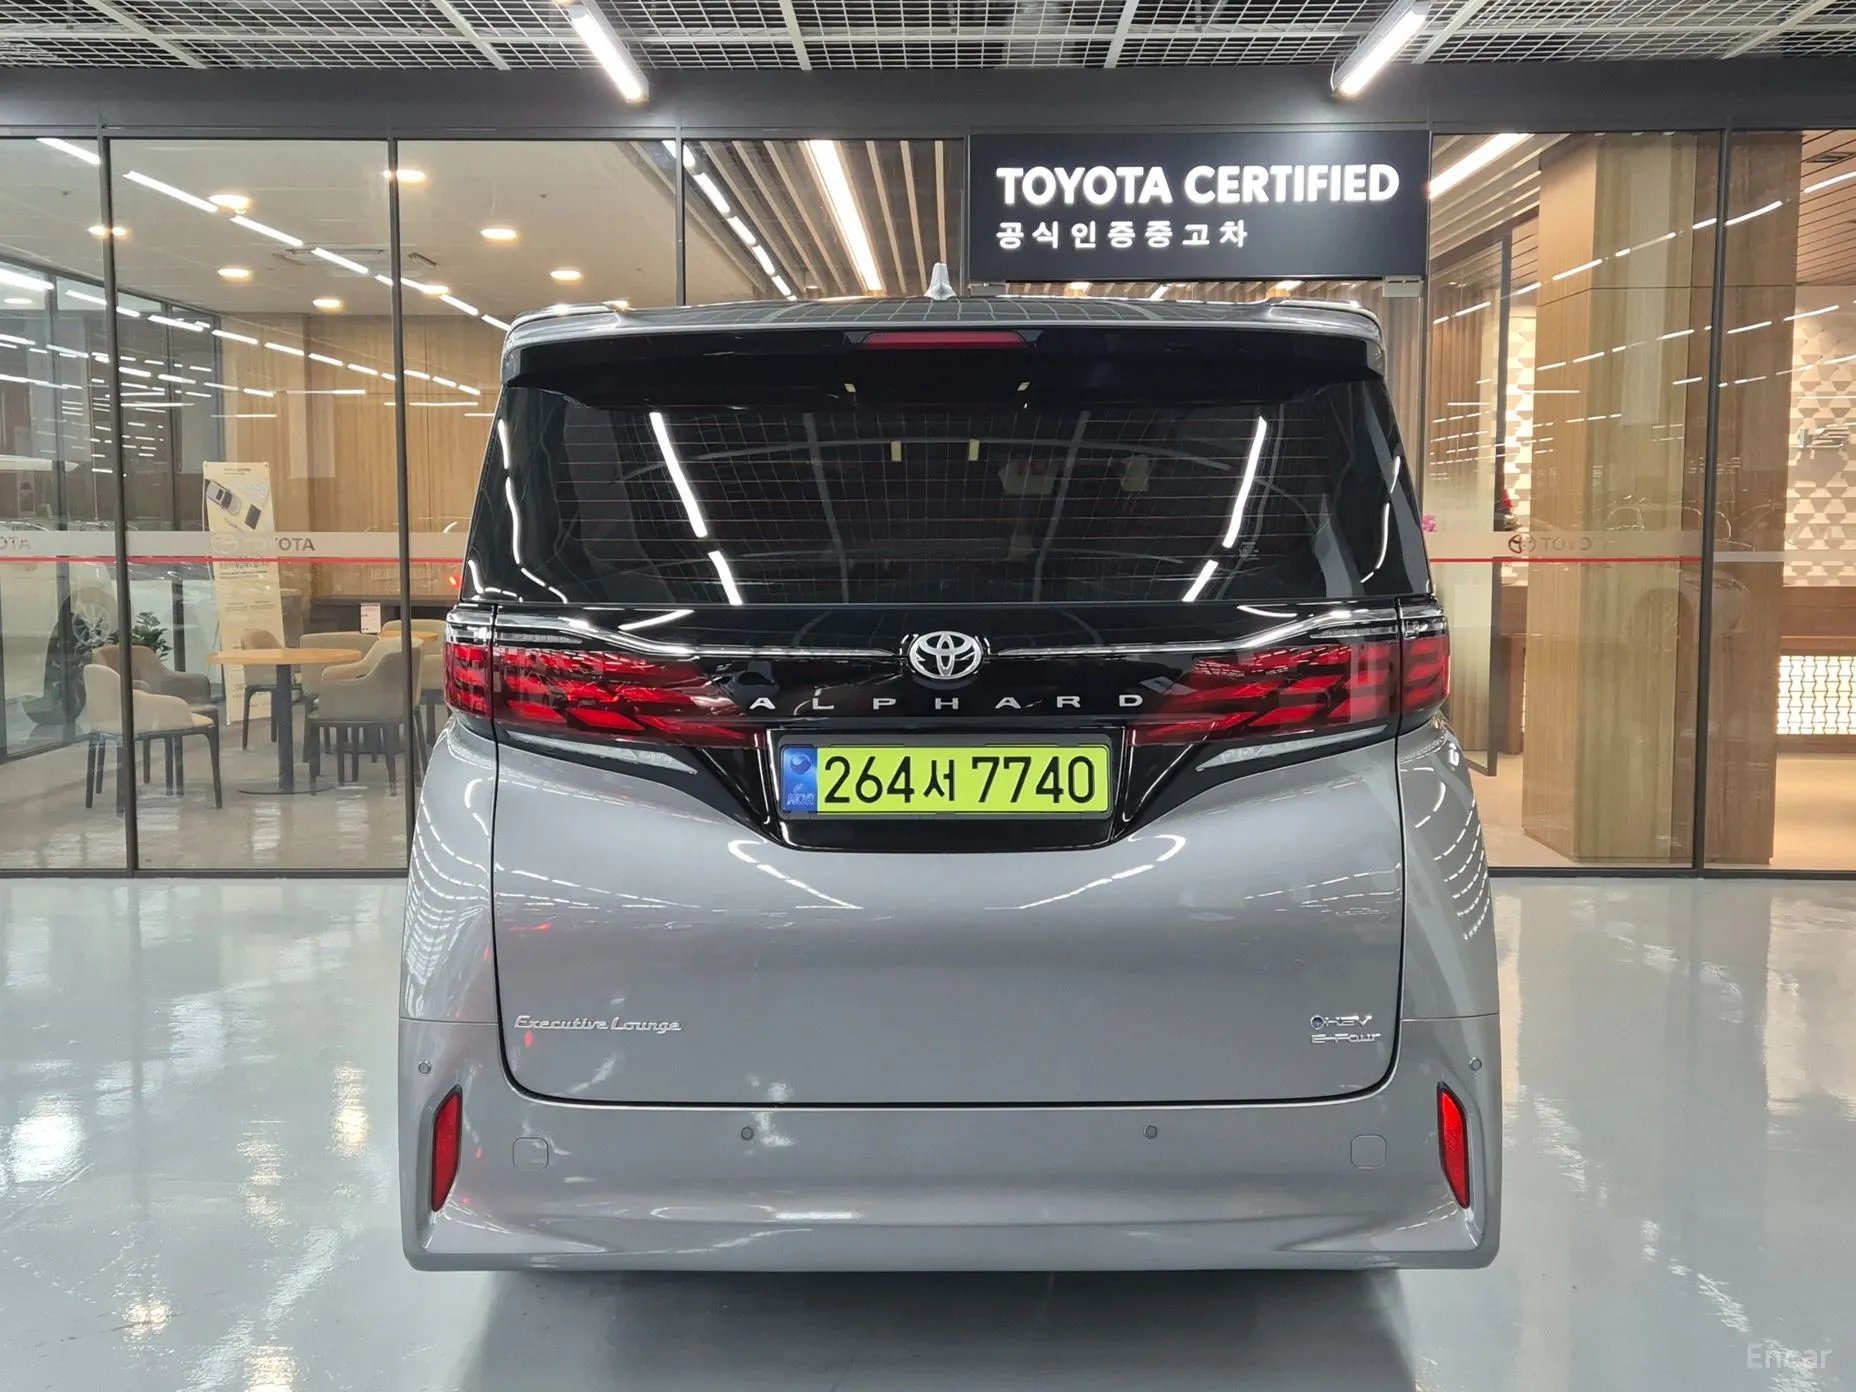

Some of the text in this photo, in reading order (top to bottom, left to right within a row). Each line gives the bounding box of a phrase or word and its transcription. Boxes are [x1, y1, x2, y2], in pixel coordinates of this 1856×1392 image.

[996, 163, 1400, 206] TOYOTA CERTIFIED
[749, 694, 1144, 710] ALPHARD
[824, 756, 1095, 803] 264서 7740
[514, 1015, 682, 1034] Executive Lounge
